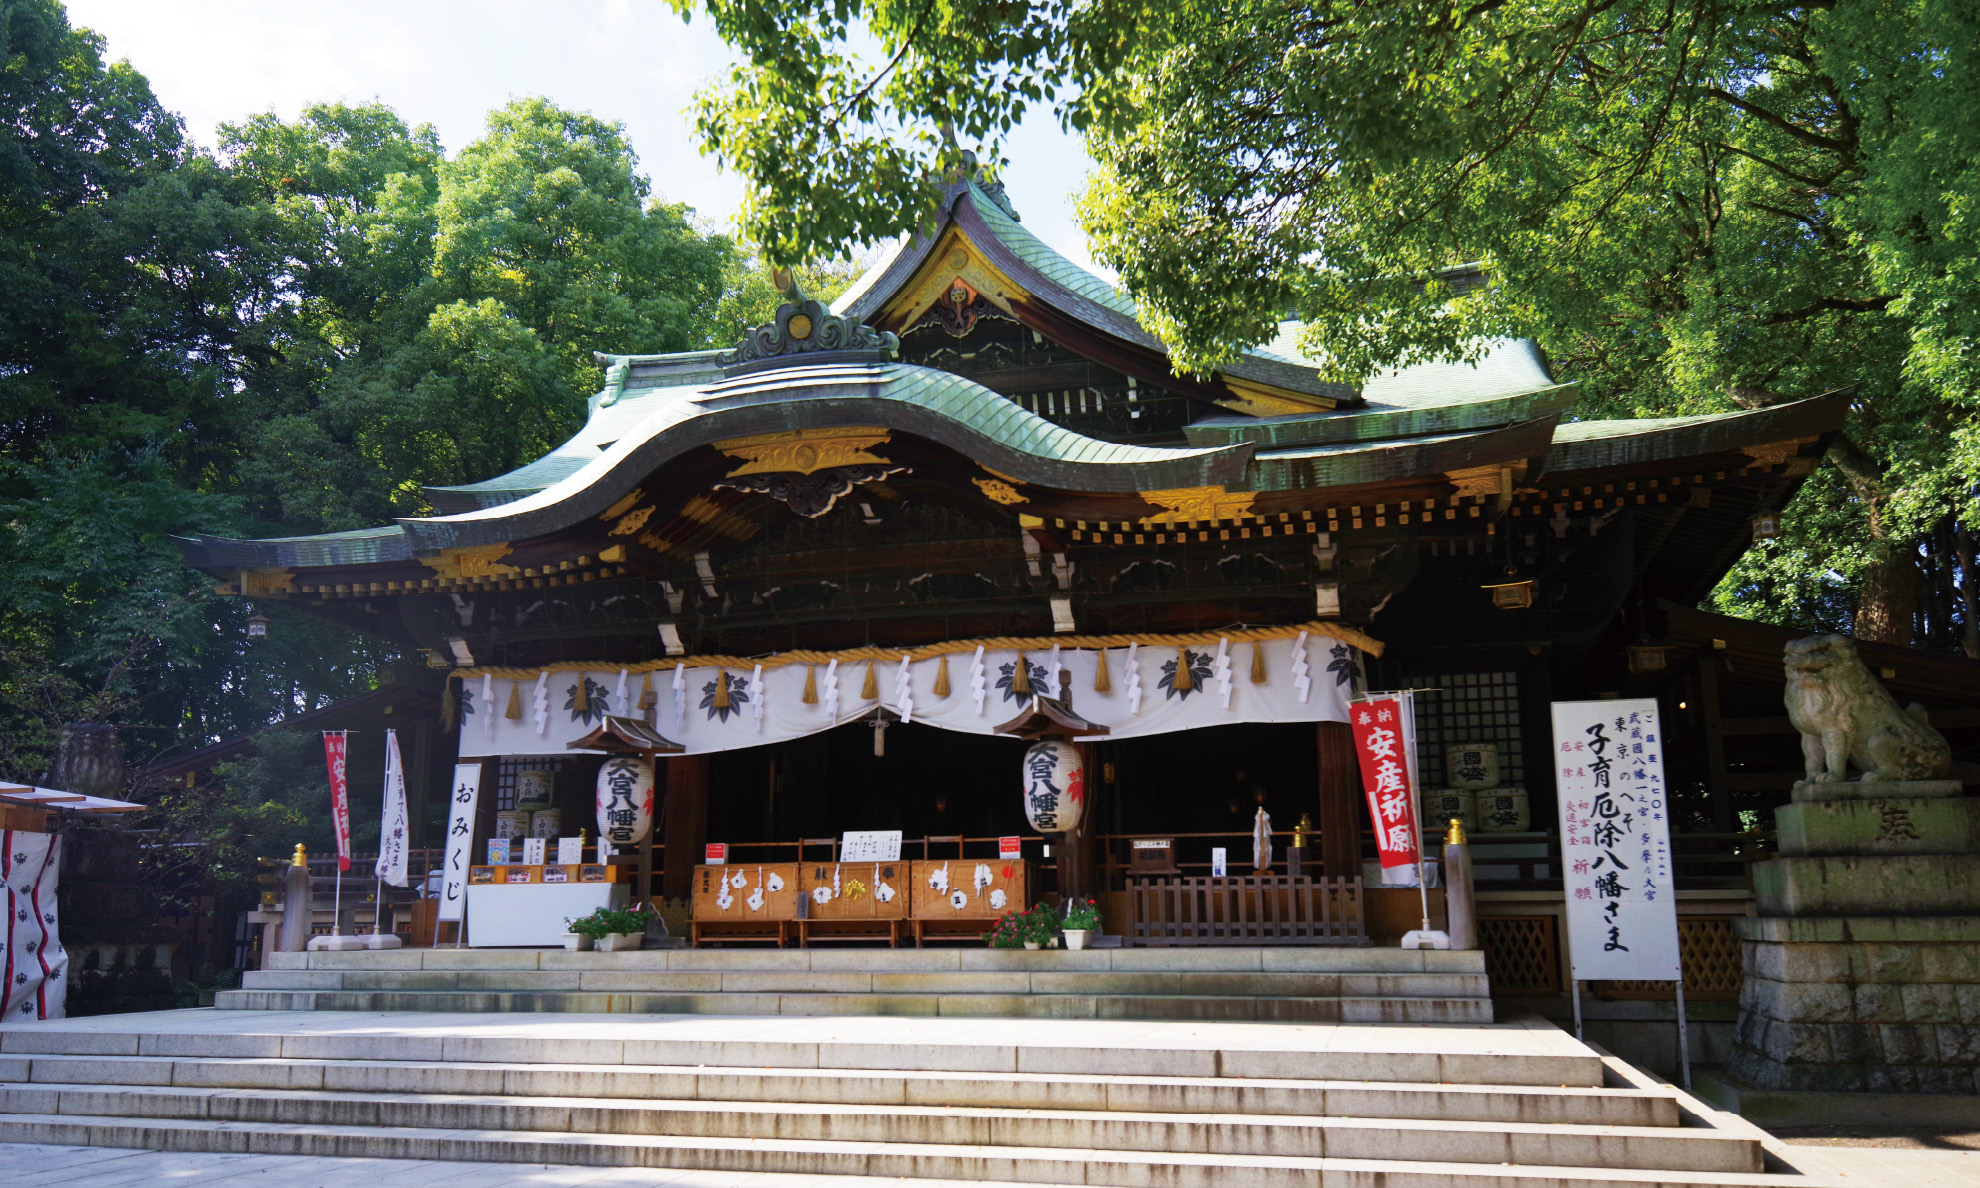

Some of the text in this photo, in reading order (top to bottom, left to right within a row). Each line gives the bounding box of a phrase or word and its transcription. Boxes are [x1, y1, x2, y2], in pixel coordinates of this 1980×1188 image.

[1358, 708, 1392, 726] 奉納
[393, 774, 405, 867] 子育て八幡さま
[606, 760, 640, 841] 大宮八幡宮
[1027, 743, 1061, 829] 大宮八幡宮
[1366, 726, 1416, 852] 安産祈願
[1614, 716, 1634, 833] 東京のへそ
[446, 783, 474, 901] おみくじ
[1572, 858, 1592, 900] 祈願
[1585, 722, 1630, 952] 子育厄除八幡さま
